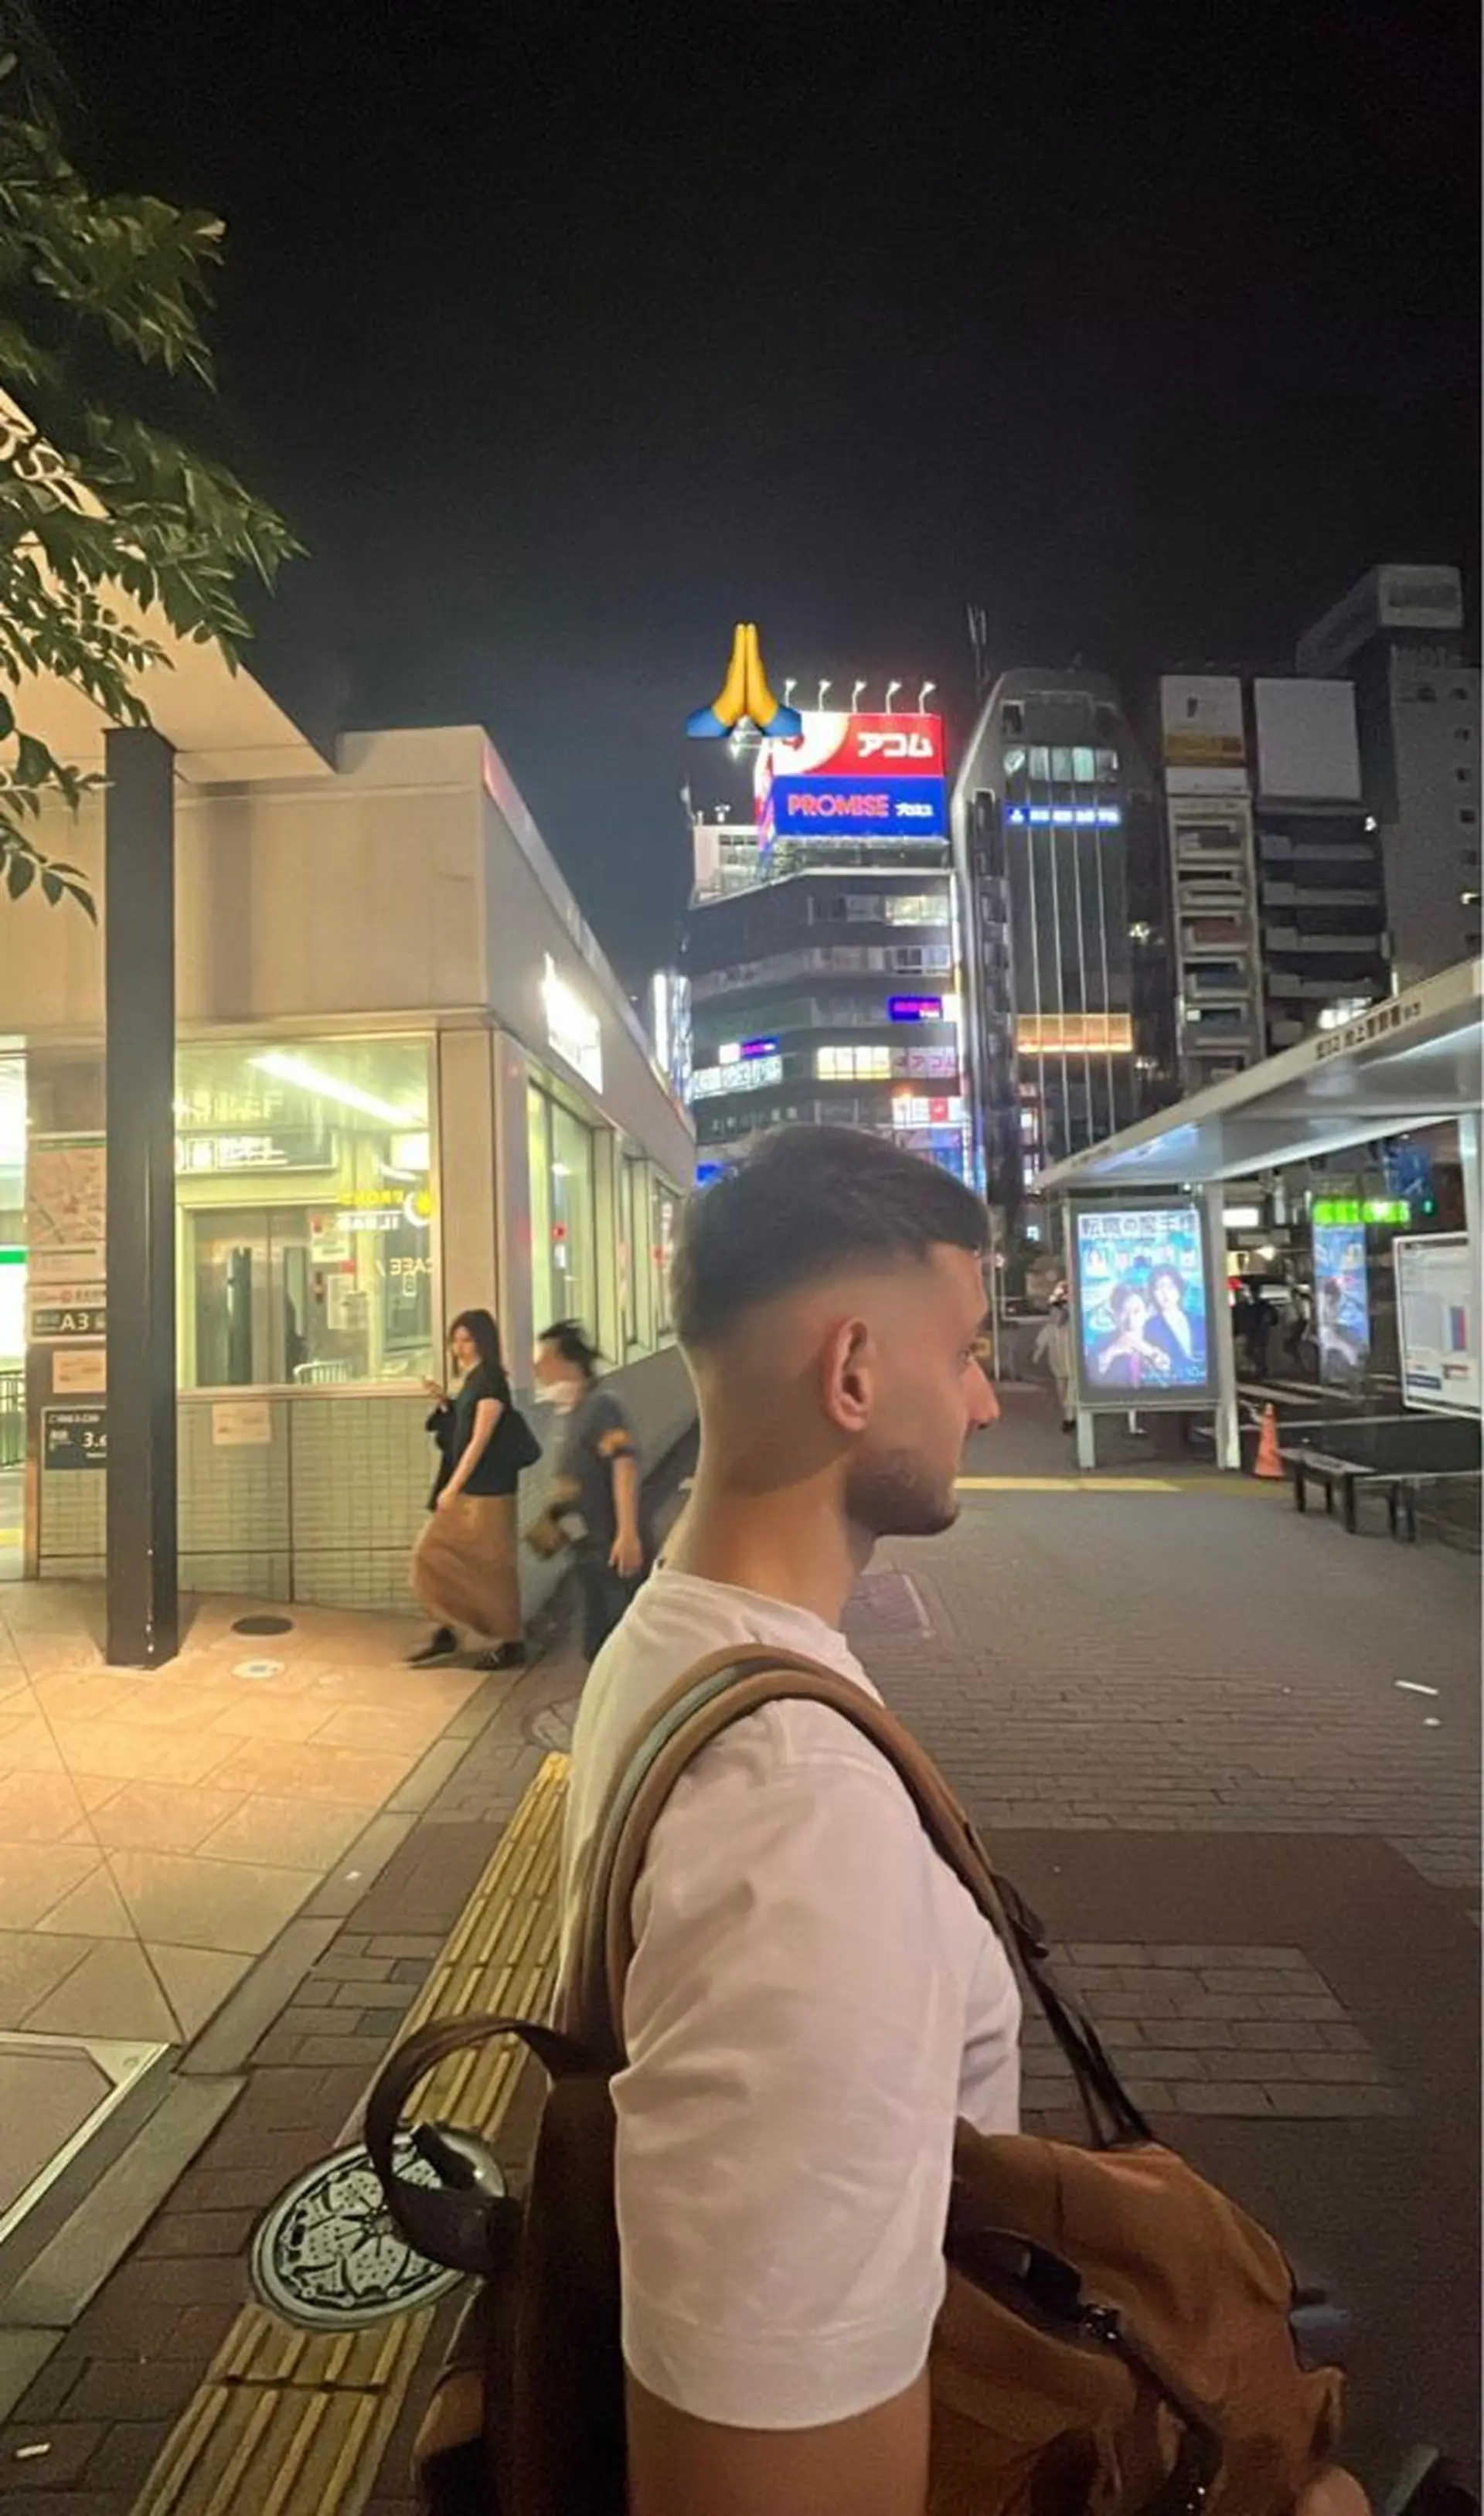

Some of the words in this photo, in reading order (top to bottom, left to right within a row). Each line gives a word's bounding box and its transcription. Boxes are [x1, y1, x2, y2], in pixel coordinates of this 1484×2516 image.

[856, 732, 934, 758] アコム
[788, 794, 889, 817] PROMISE
[60, 1312, 90, 1331] A3
